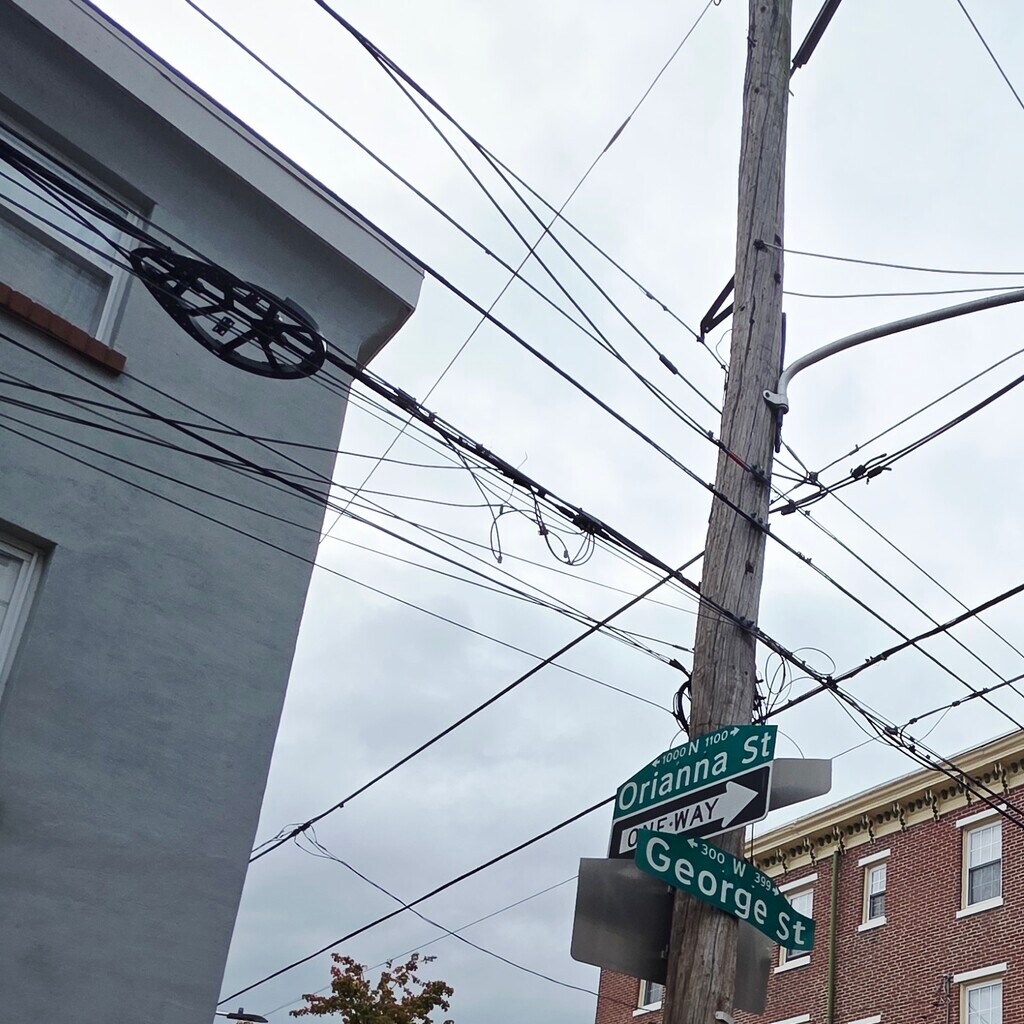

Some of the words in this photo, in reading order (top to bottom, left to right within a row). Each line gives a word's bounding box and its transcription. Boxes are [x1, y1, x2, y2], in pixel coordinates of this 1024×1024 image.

[662, 746, 686, 764] 1000
[688, 738, 699, 756] N
[705, 730, 728, 747] 1100
[618, 751, 728, 811] Orianna
[742, 732, 771, 764] St
[675, 798, 719, 831] WAY
[646, 836, 767, 925] George
[776, 911, 806, 945] St
[701, 843, 725, 864] 300
[733, 858, 746, 878] W
[754, 872, 772, 891] 399
